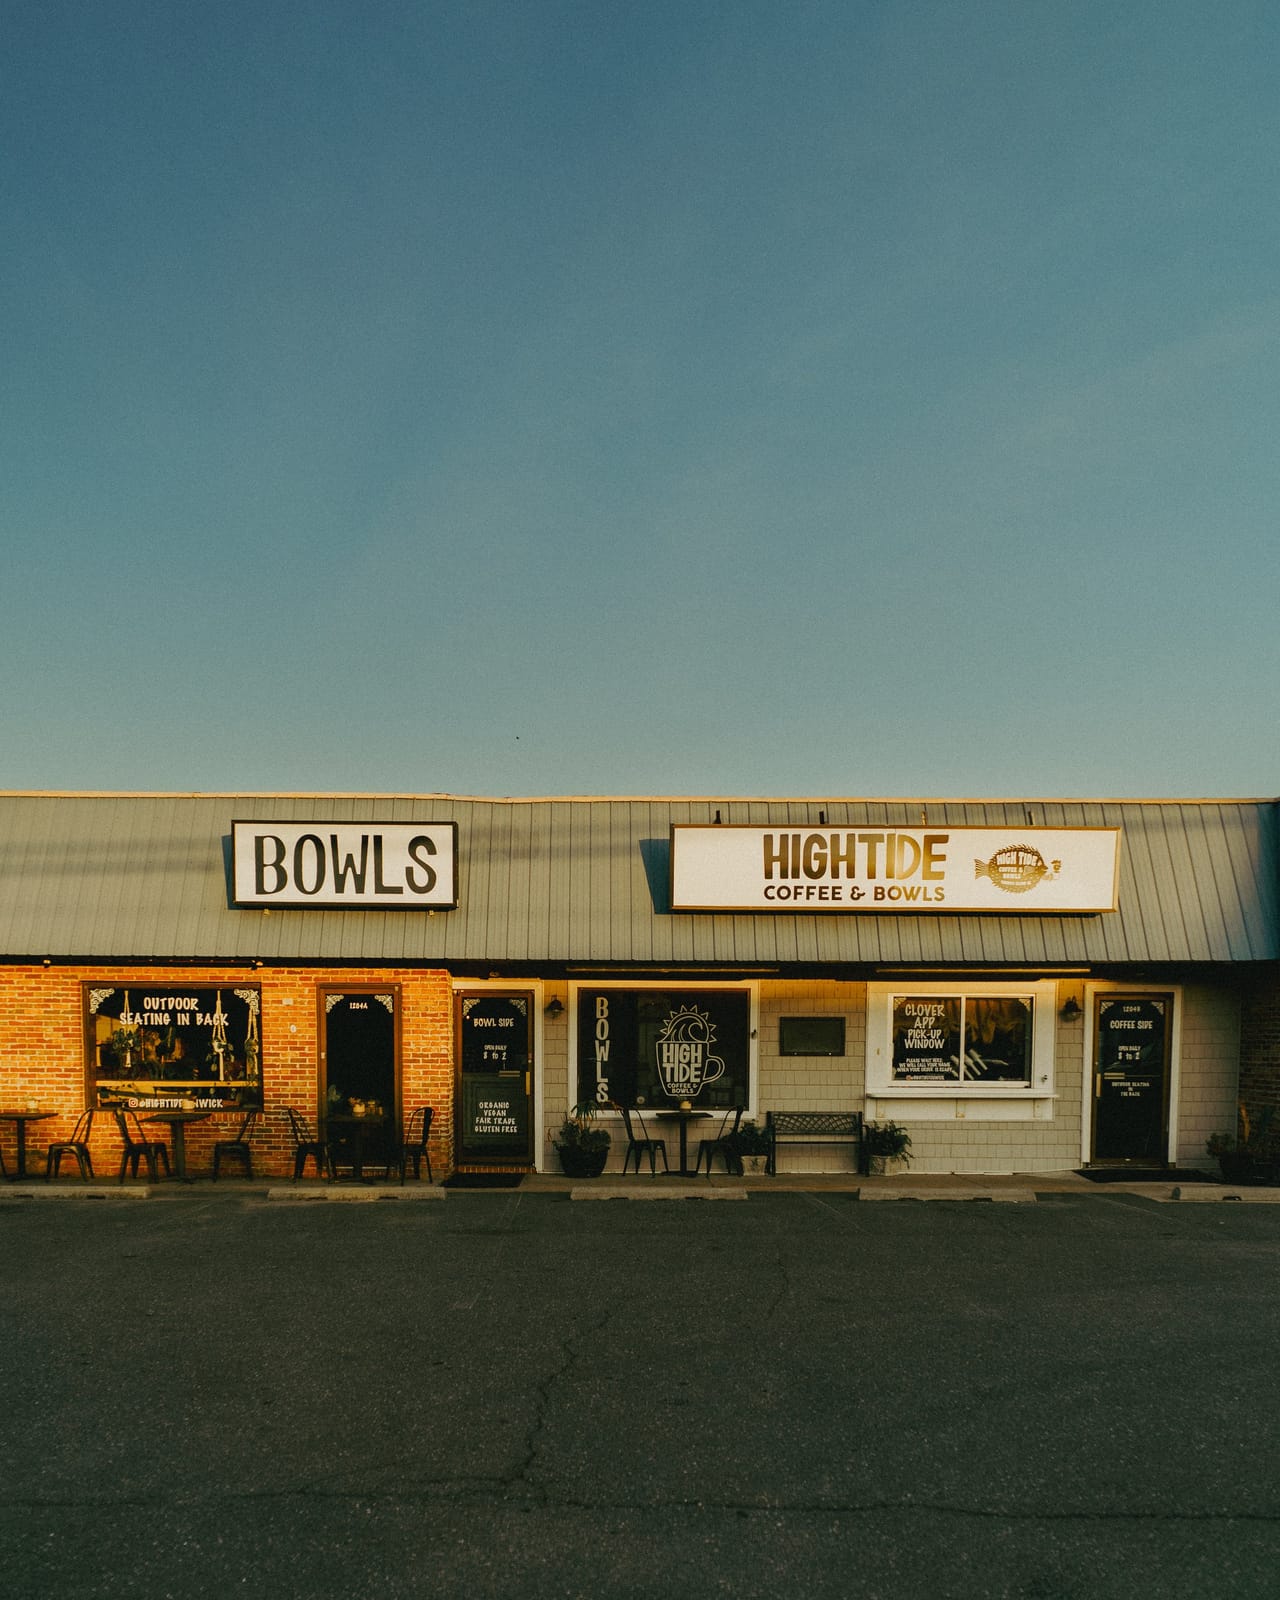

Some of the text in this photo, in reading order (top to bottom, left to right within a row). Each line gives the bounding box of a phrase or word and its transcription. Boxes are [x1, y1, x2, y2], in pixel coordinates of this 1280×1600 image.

[254, 834, 437, 895] BOWLS
[996, 851, 1038, 867] HIGH TIDE
[764, 885, 945, 903] COFFEE & BOWLS
[143, 997, 199, 1011] OUTDOOR
[905, 1003, 945, 1017] CLOVER
[120, 1012, 229, 1026] SEATING IN BACK
[473, 1018, 514, 1028] BOWL SIDE
[914, 1017, 935, 1029] APP
[1110, 1020, 1153, 1029] COFFEE SIDE
[908, 1029, 942, 1039] PICK-UP
[595, 997, 610, 1102] BOWLS
[904, 1039, 945, 1049] WINDOW
[492, 1051, 499, 1060] to
[501, 1052, 507, 1060] 2
[662, 1043, 702, 1064] HIGH
[662, 1063, 702, 1083] TIDE
[483, 1109, 506, 1117] VEGAN
[475, 1117, 515, 1125] FAIR TRADE
[474, 1125, 517, 1133] GLUTEN FREE
